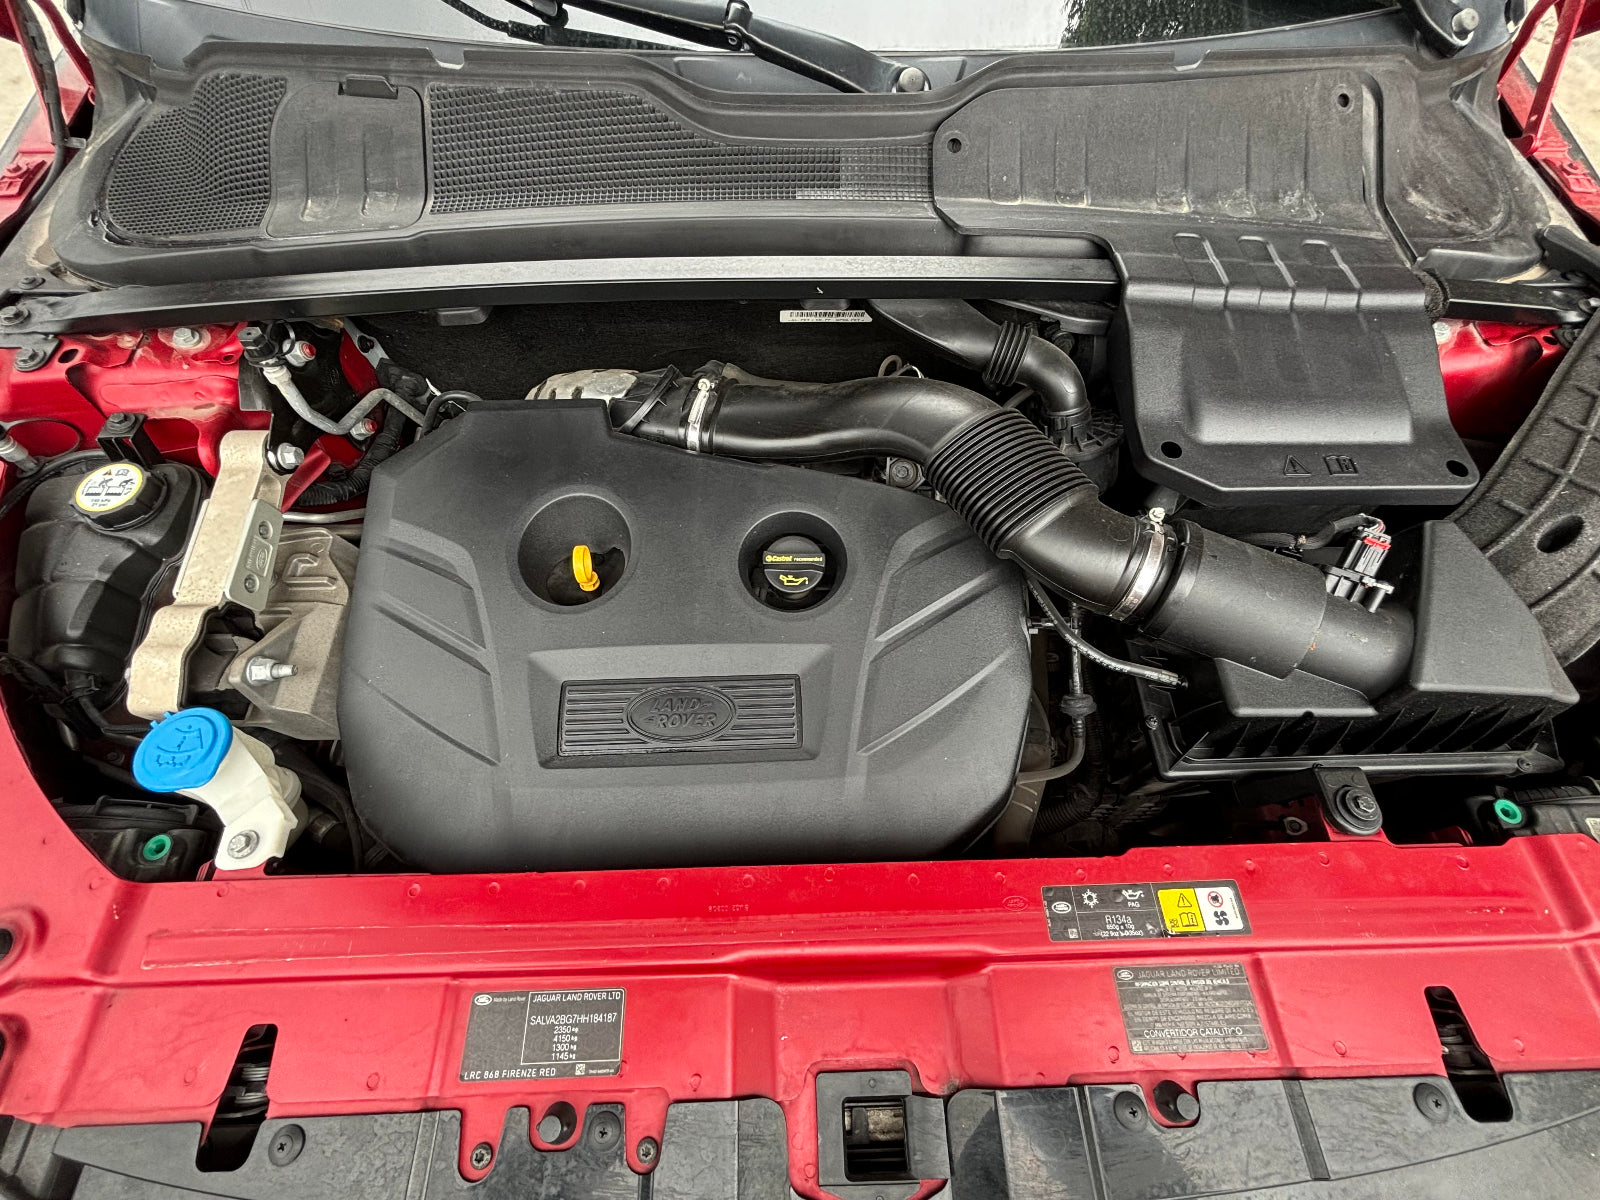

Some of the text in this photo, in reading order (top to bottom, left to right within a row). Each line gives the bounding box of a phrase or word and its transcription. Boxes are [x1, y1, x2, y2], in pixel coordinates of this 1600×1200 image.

[1105, 915, 1132, 925] R134a
[1138, 970, 1165, 979] JAGUAR
[1167, 969, 1187, 978] LAND
[1212, 966, 1240, 976] LIMITED
[533, 991, 621, 1003] JAGUAR LAND ROVER LTD
[530, 1012, 617, 1026] SALVA2BG7HH184187
[554, 1025, 571, 1034] 2350
[1144, 1028, 1199, 1039] CONVERTIDOR
[553, 1034, 570, 1043] 4150
[552, 1043, 569, 1051] 1300
[551, 1052, 569, 1060] 1145
[464, 1067, 556, 1080] LRC 868 FIRENZE RED
